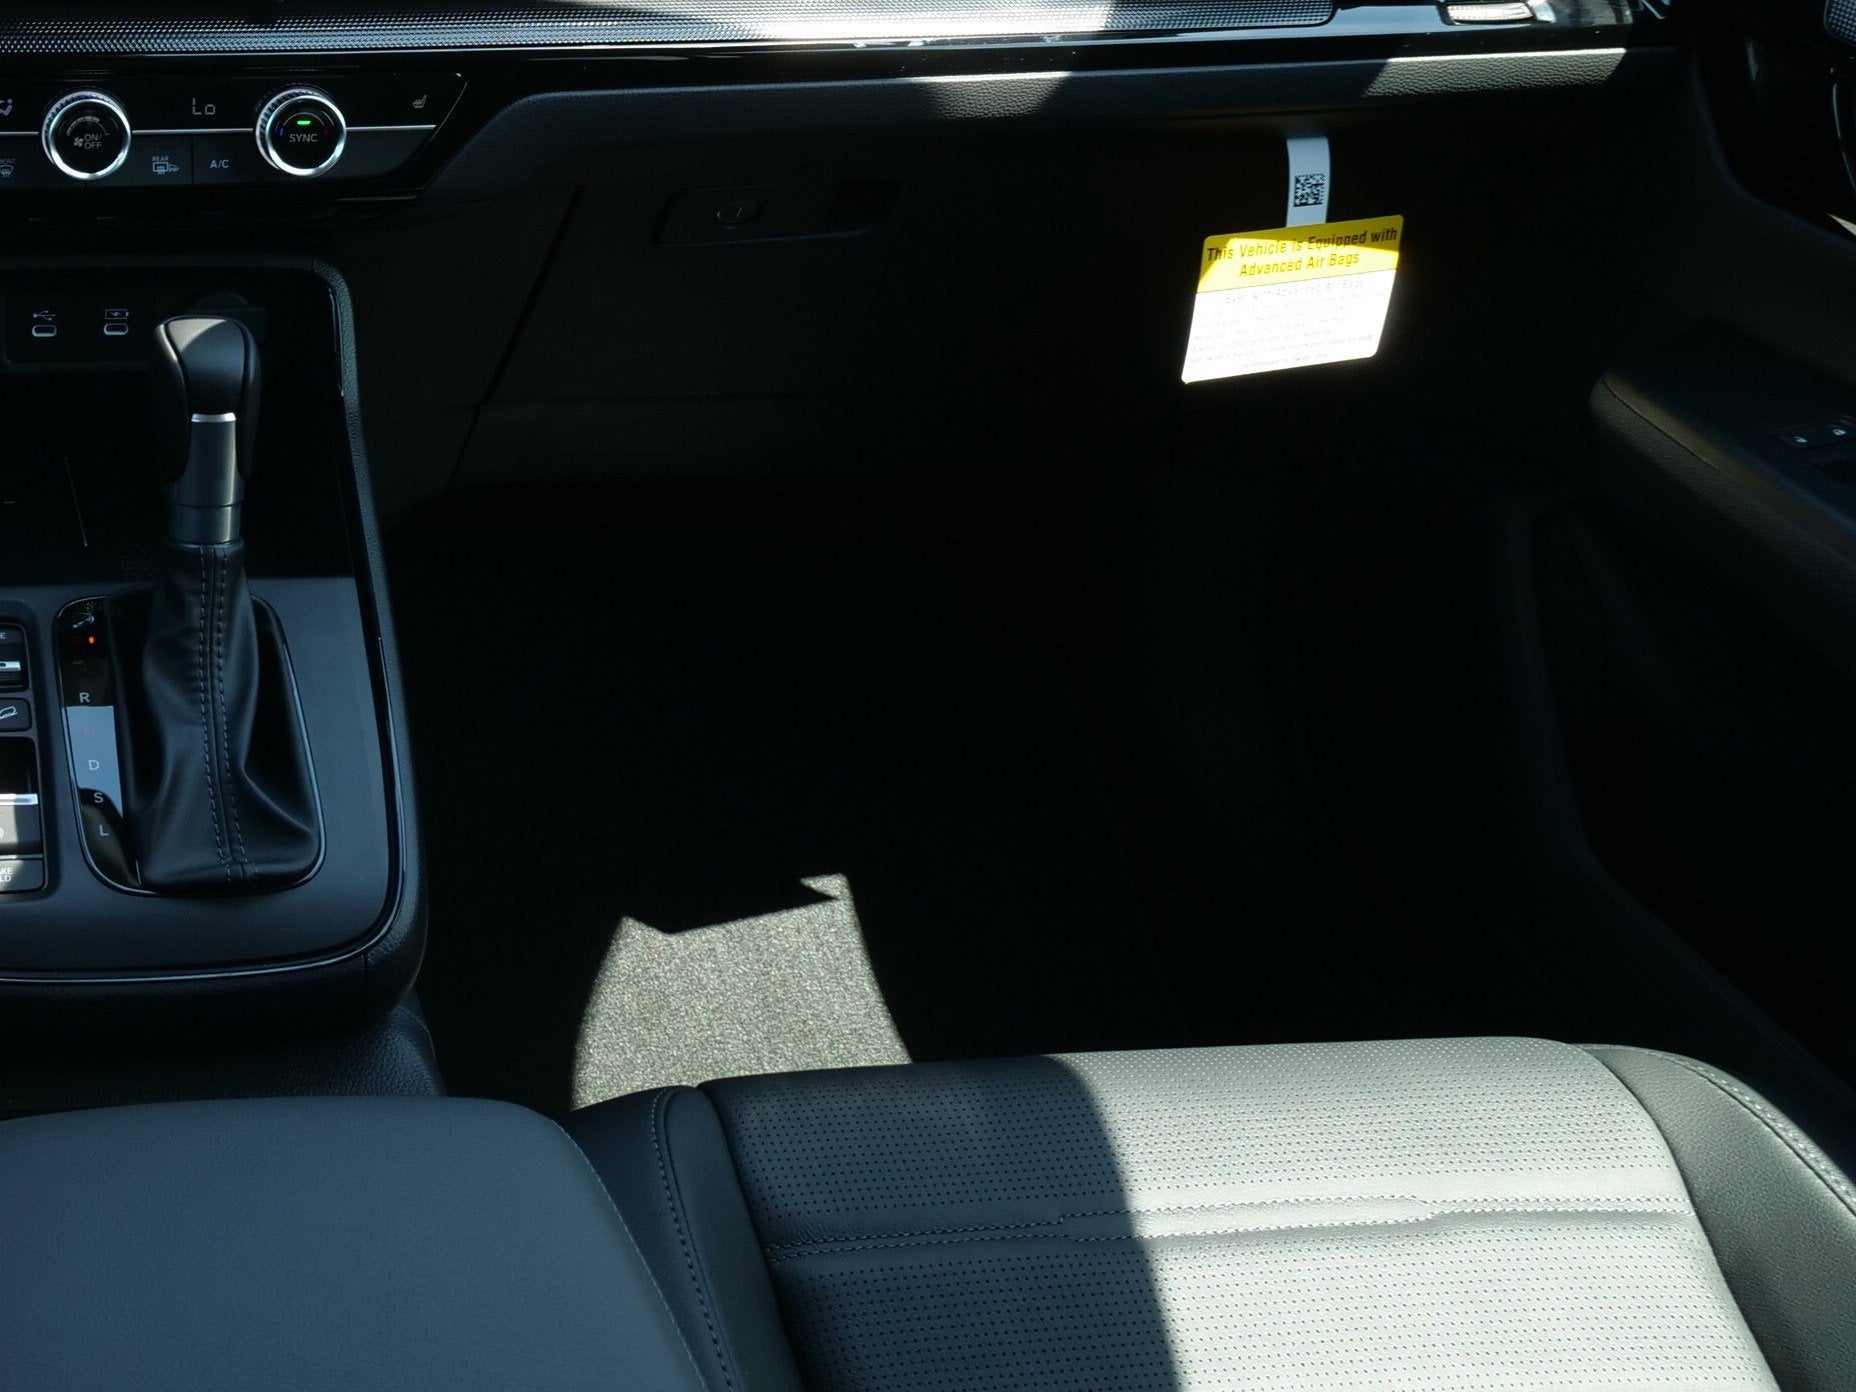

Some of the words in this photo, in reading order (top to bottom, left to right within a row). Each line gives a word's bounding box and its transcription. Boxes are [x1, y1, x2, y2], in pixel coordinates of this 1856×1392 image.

[84, 133, 101, 142] ON/
[289, 133, 318, 143] SYNC
[84, 142, 102, 150] OFF
[210, 159, 230, 169] A/C
[1206, 247, 1234, 262] This
[1239, 239, 1287, 257] Vehicle
[1292, 238, 1303, 252] is
[1307, 230, 1367, 251] Equipped
[1370, 227, 1398, 241] with
[1239, 260, 1302, 278] Advanced
[1306, 257, 1324, 269] Air
[1329, 253, 1360, 268] Bags
[79, 692, 90, 703] R
[88, 759, 100, 770] D
[94, 792, 104, 803] S
[99, 825, 109, 836] L
